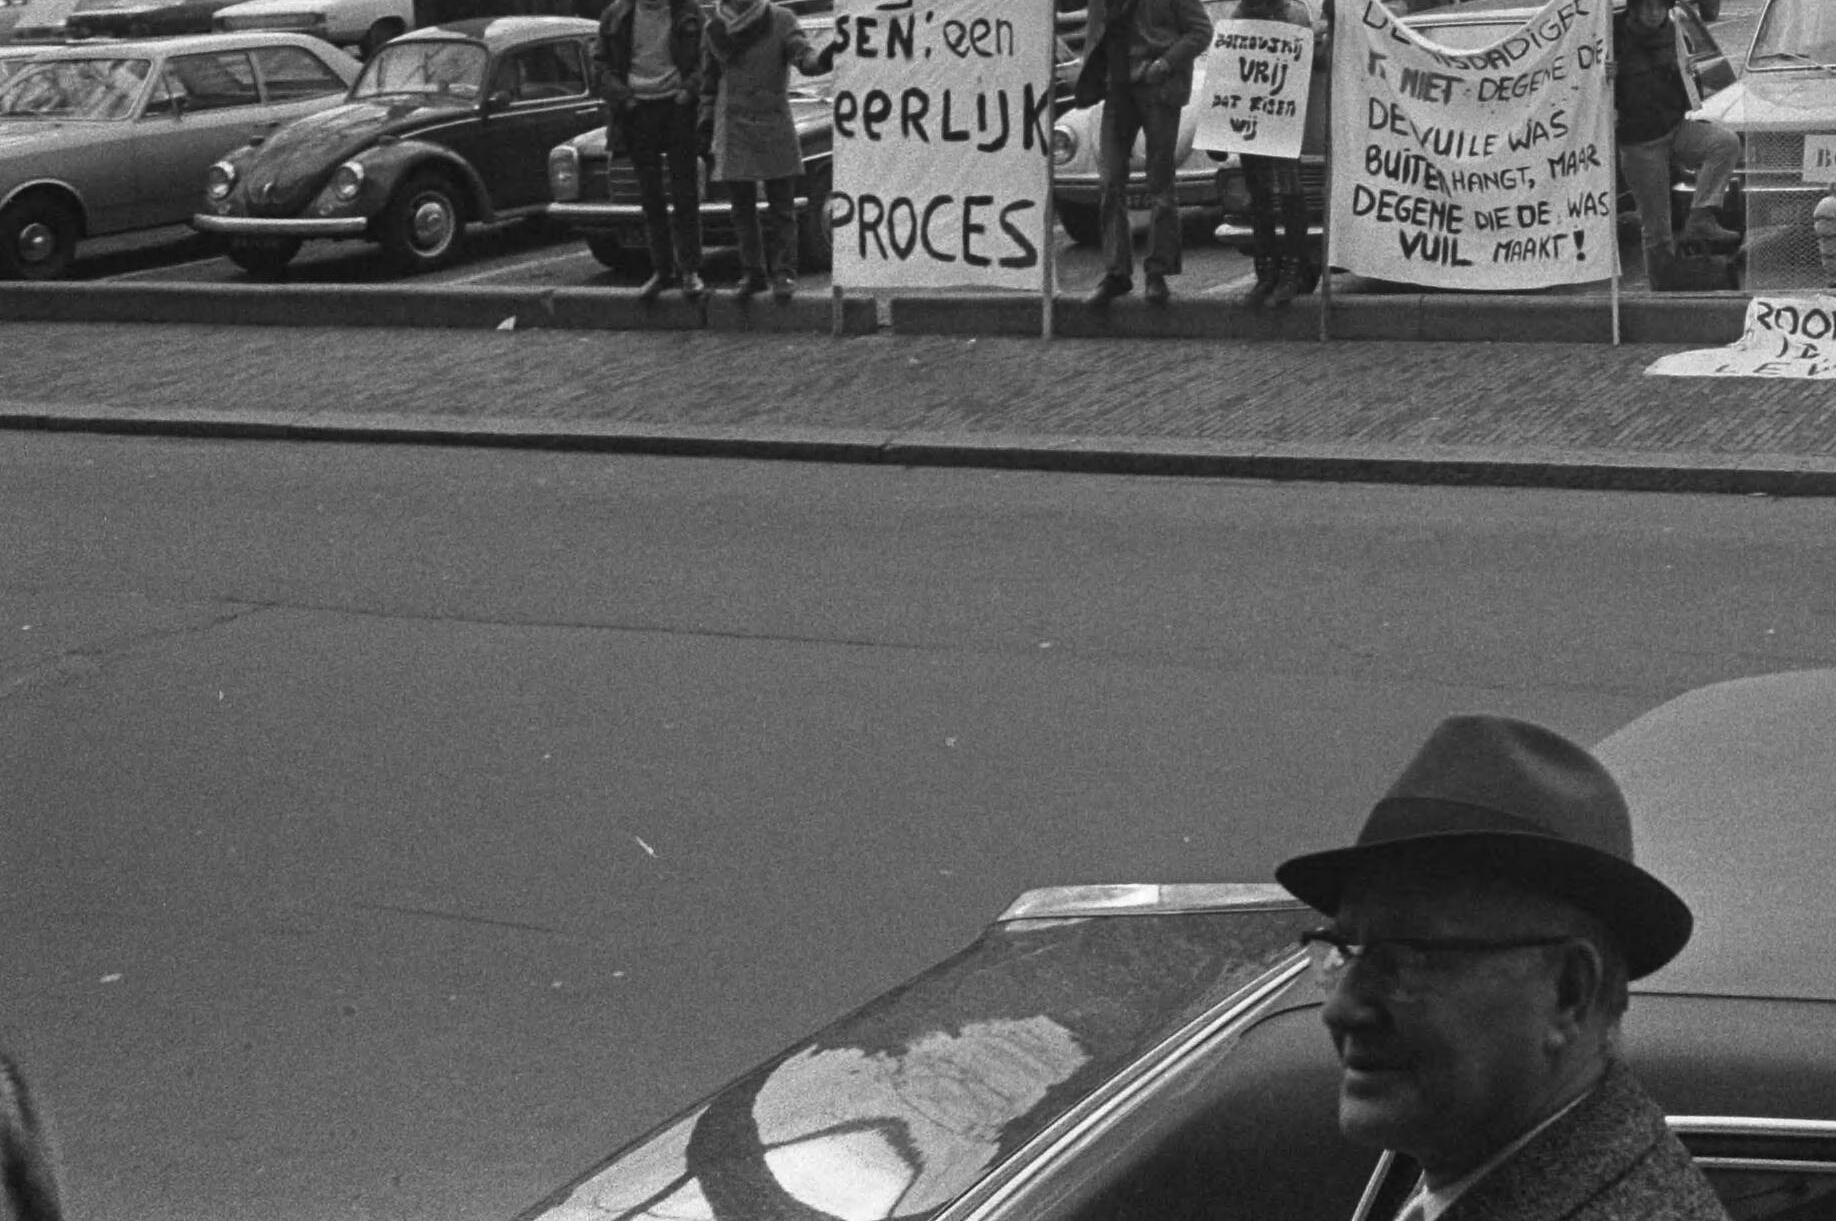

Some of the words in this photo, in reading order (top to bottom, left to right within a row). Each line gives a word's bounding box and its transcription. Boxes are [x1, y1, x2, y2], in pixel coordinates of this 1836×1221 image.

[1368, 97, 1409, 136] DE
[1507, 109, 1569, 153] WAS
[1546, 143, 1601, 179] MAAR
[1566, 191, 1610, 219] WAS
[826, 191, 1038, 269] PROCES
[1400, 229, 1473, 267] VUIL
